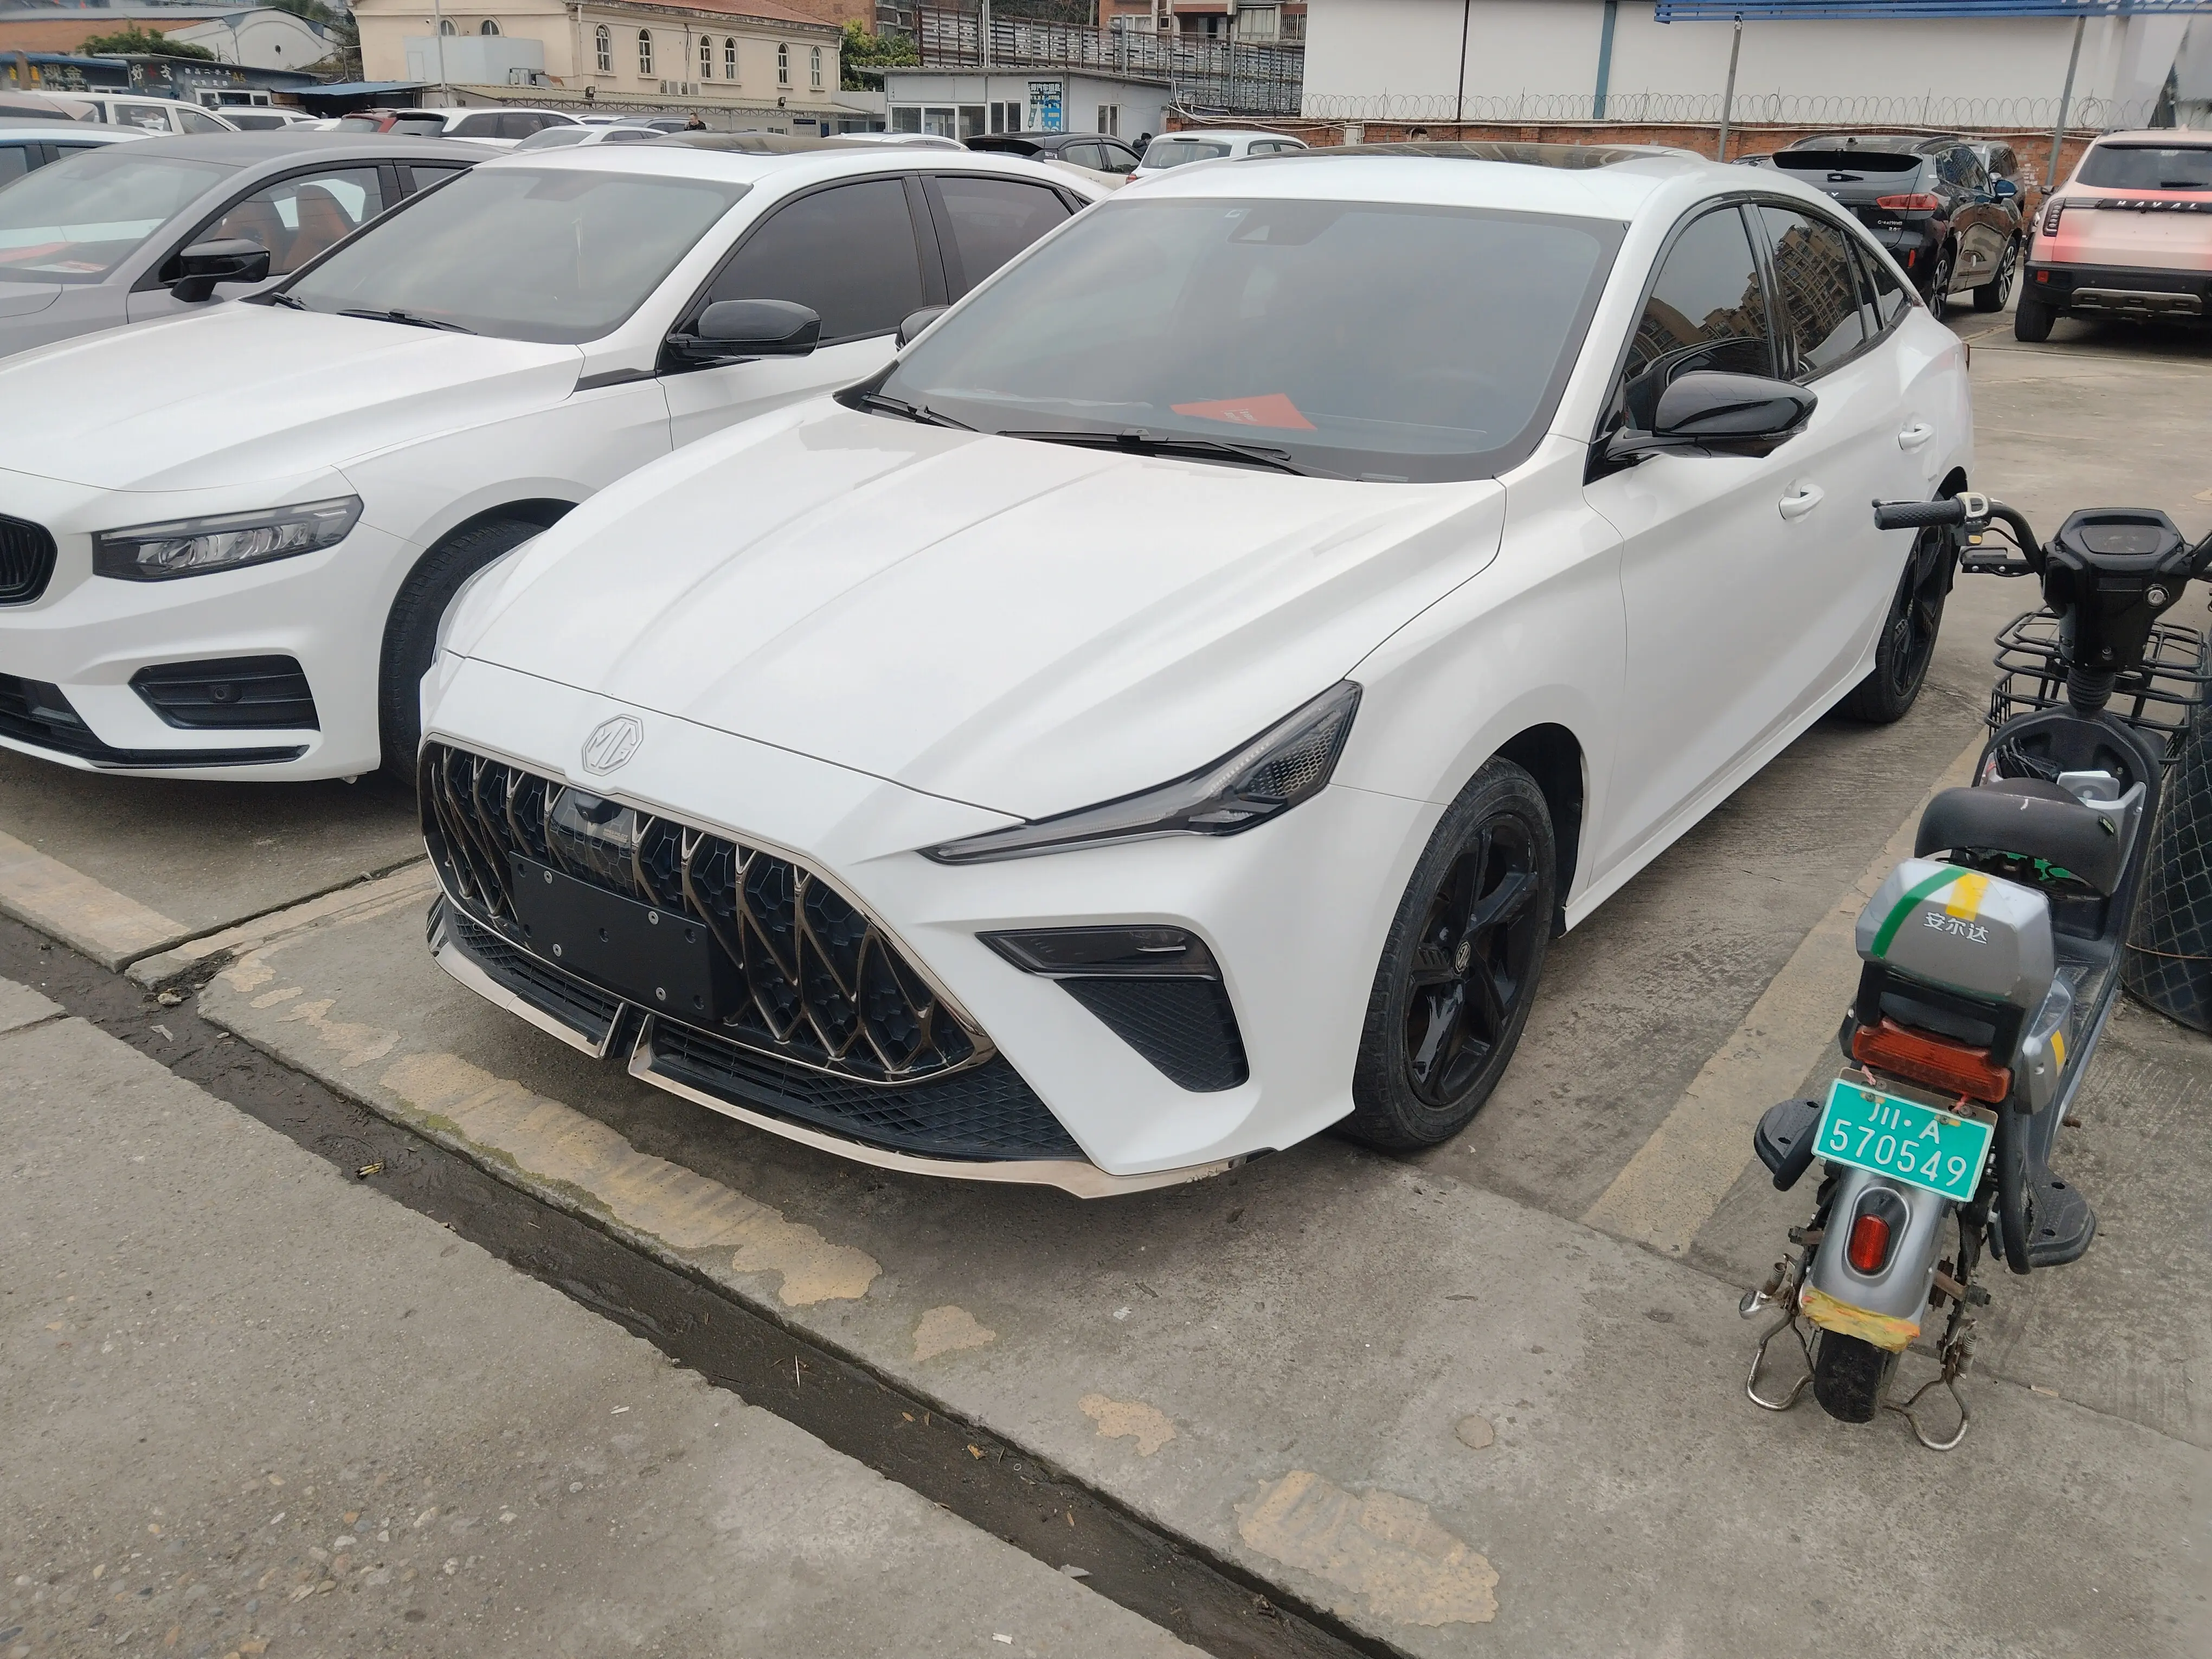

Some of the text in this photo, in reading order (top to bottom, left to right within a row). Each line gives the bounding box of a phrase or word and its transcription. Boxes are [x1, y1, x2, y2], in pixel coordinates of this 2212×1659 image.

[2117, 200, 2197, 209] HAVAL
[586, 717, 640, 773] MG
[1923, 911, 1989, 944] 安尔达
[1829, 1118, 1967, 1187] 570549
